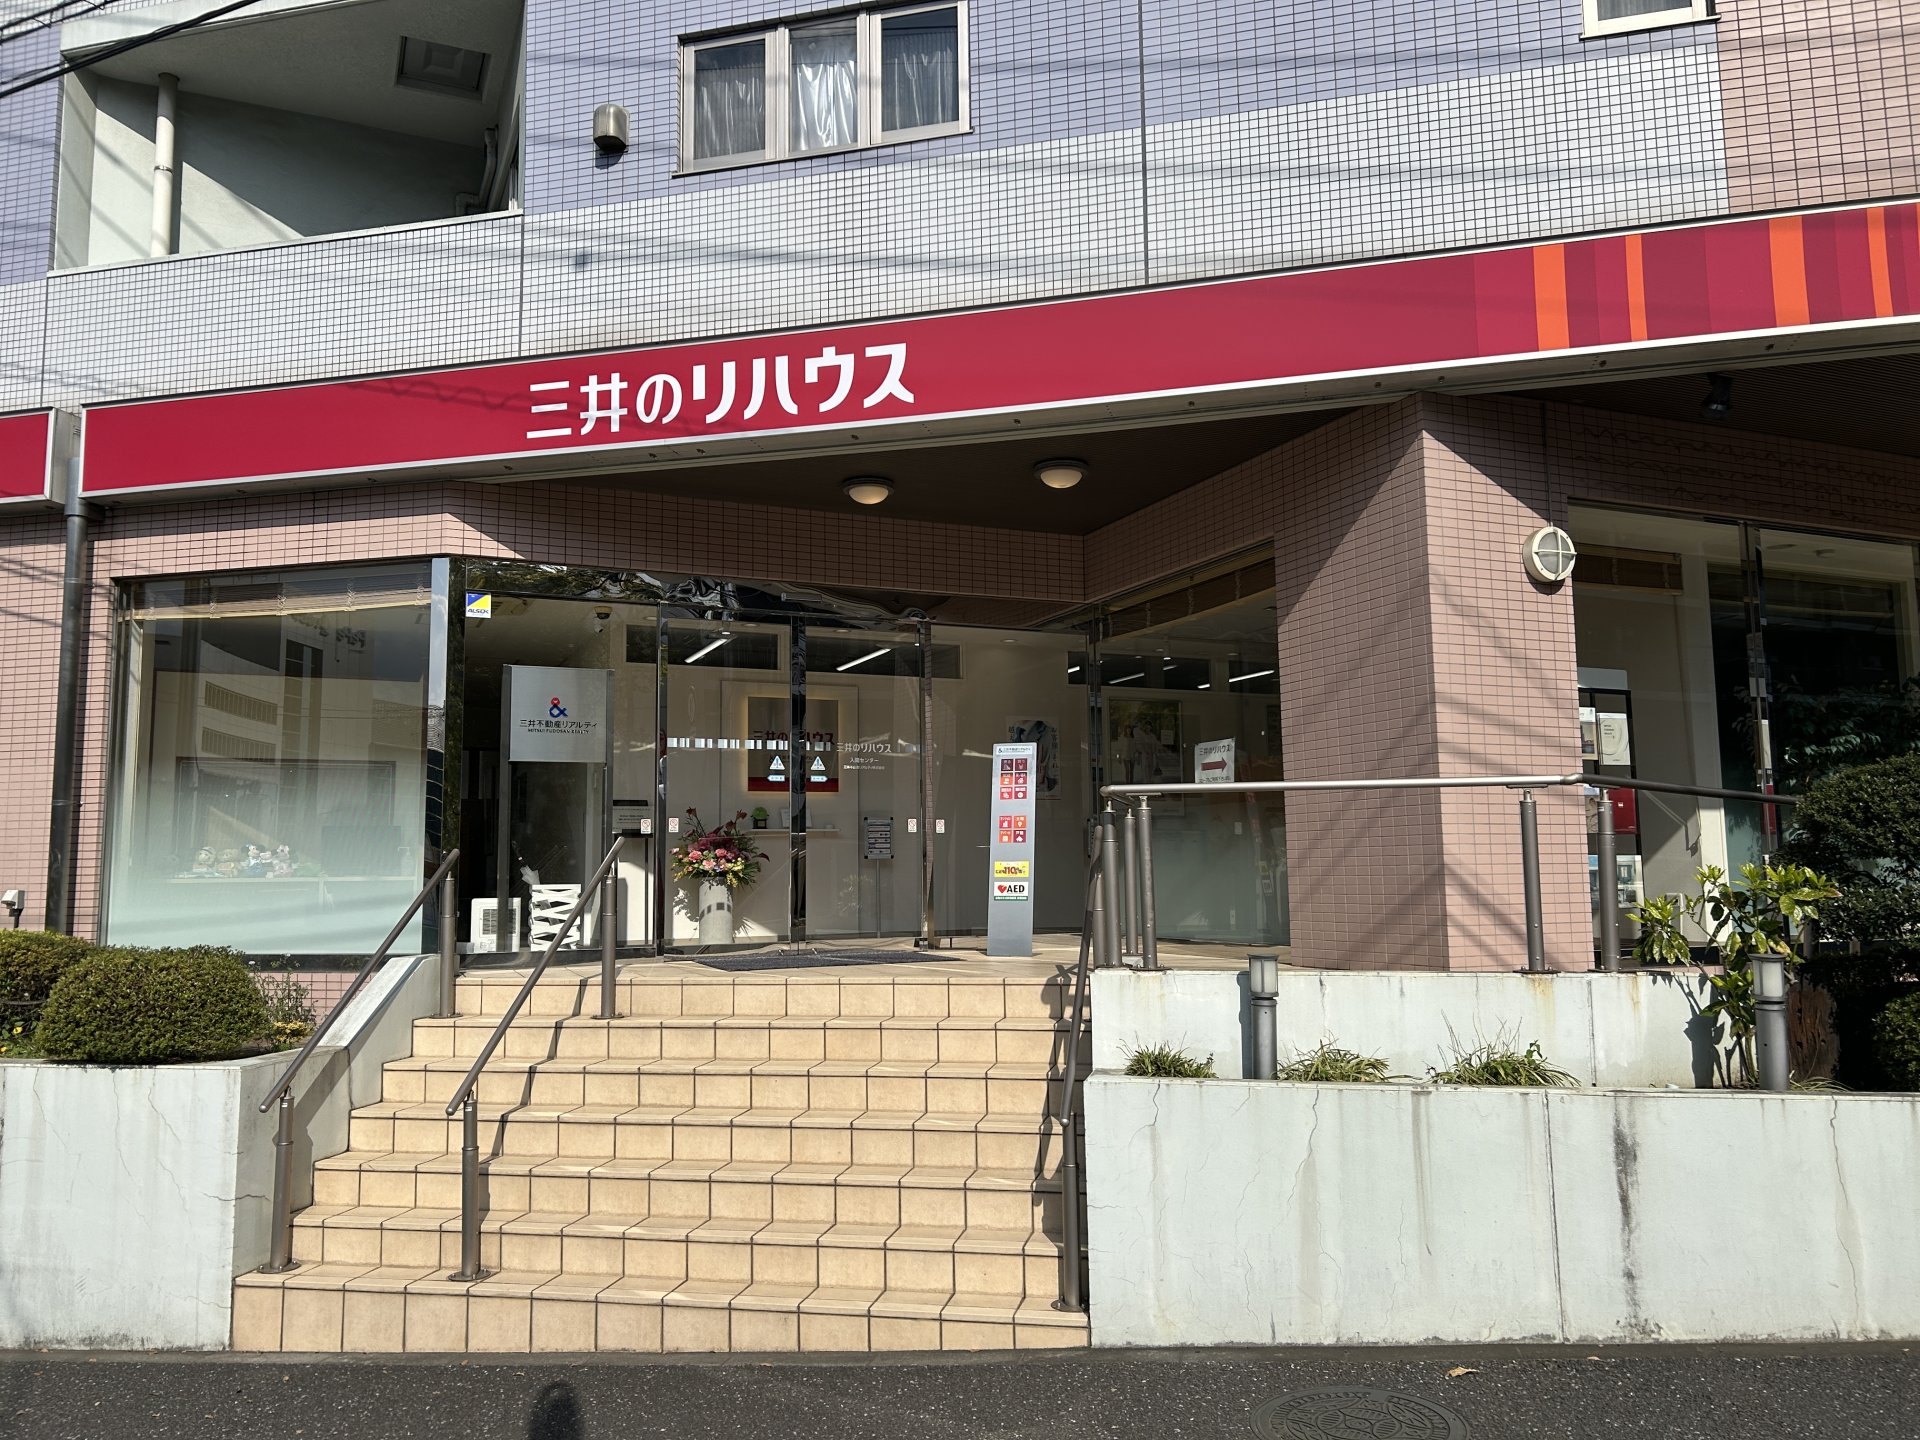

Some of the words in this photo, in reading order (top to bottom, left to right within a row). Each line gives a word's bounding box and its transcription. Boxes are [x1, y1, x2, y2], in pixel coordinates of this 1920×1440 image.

[526, 342, 915, 439] 三井のリハウス
[520, 719, 597, 729] 三井不動産リアルティ
[837, 743, 891, 752] 三井のリハウス
[1007, 885, 1025, 893] AED
